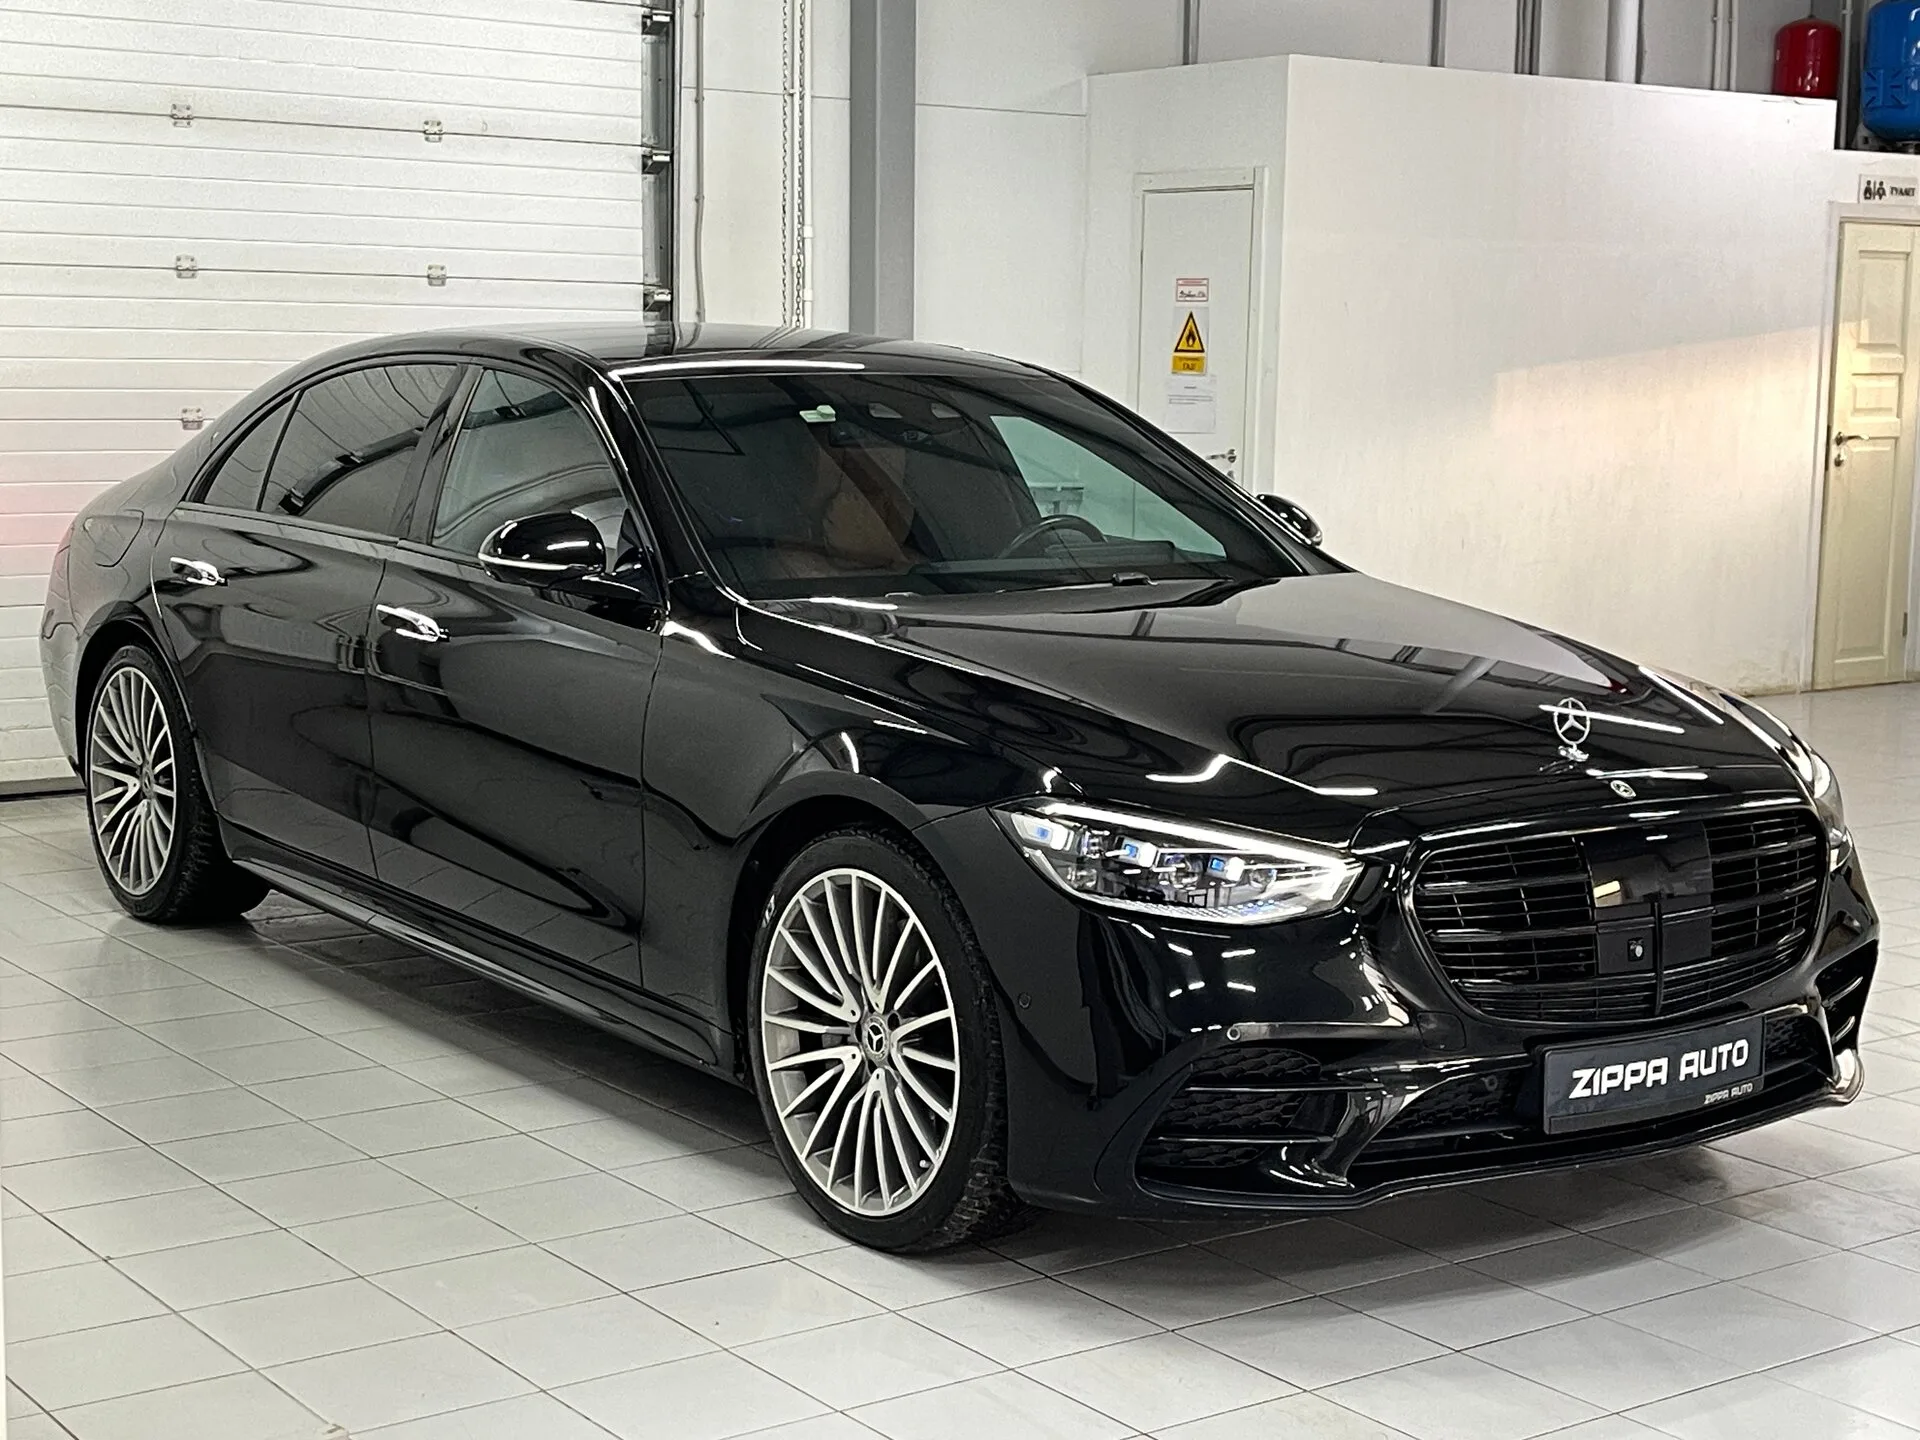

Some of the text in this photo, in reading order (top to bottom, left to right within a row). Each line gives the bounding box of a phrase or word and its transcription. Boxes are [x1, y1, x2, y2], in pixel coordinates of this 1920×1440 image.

[1569, 1039, 1749, 1099] ZIPPA AUTO
[1704, 1082, 1753, 1104] ZIPPA AUTO
